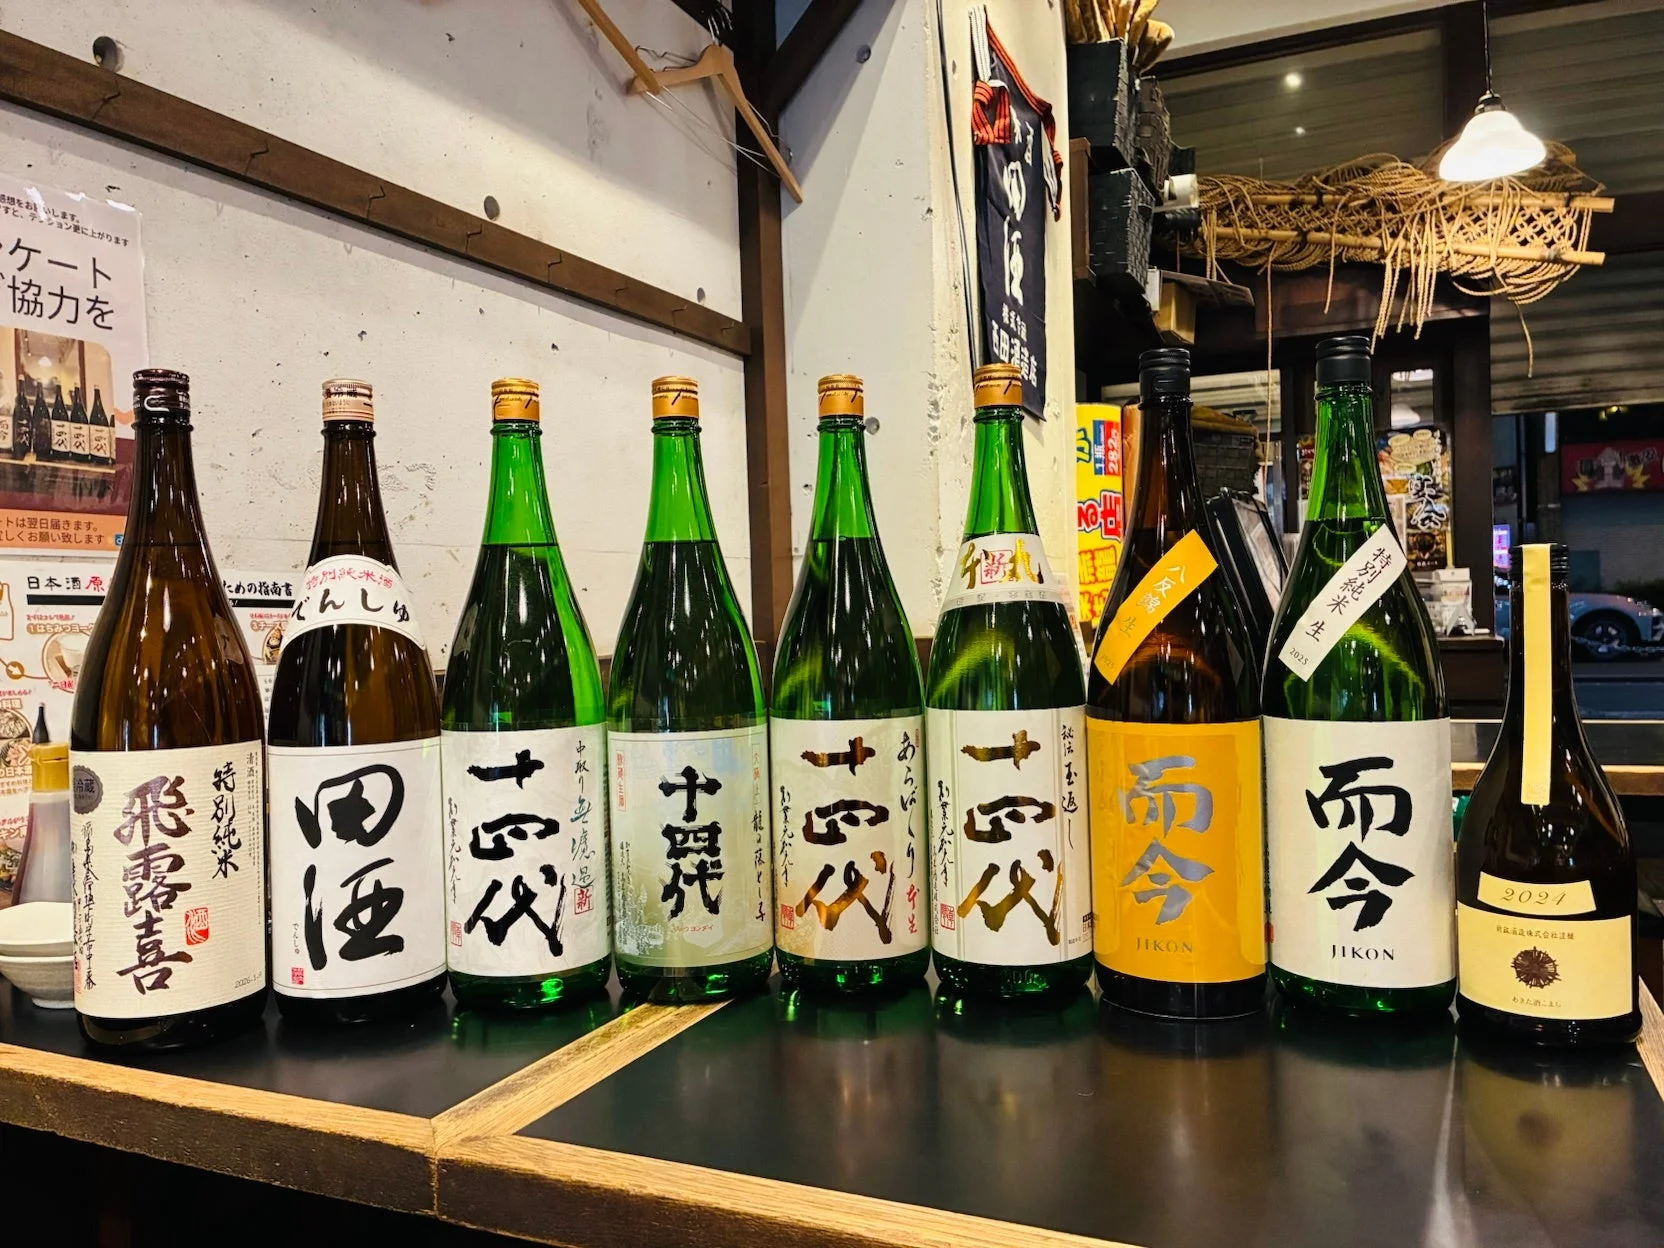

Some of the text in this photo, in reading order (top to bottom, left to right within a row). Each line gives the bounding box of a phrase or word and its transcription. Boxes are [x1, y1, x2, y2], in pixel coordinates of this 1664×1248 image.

[0, 237, 111, 289] ケート
[0, 272, 114, 331] 協力を
[0, 515, 99, 532] トは翌日届きます。
[305, 566, 394, 591] 特別純米酒
[1305, 546, 1392, 643] 特別純米 生
[211, 761, 242, 879] 特別純米
[294, 763, 405, 971] 田酒
[466, 749, 564, 958] 十四代
[658, 765, 725, 921] 十四代
[801, 736, 896, 944] 十四代
[957, 729, 1063, 946] 十四代
[1117, 755, 1216, 926] 而今
[1305, 756, 1416, 932] 而今
[113, 775, 194, 996] 飛露喜
[1501, 887, 1567, 906] 2024
[1135, 937, 1194, 954] JIKON
[1330, 944, 1395, 961] JIKON
